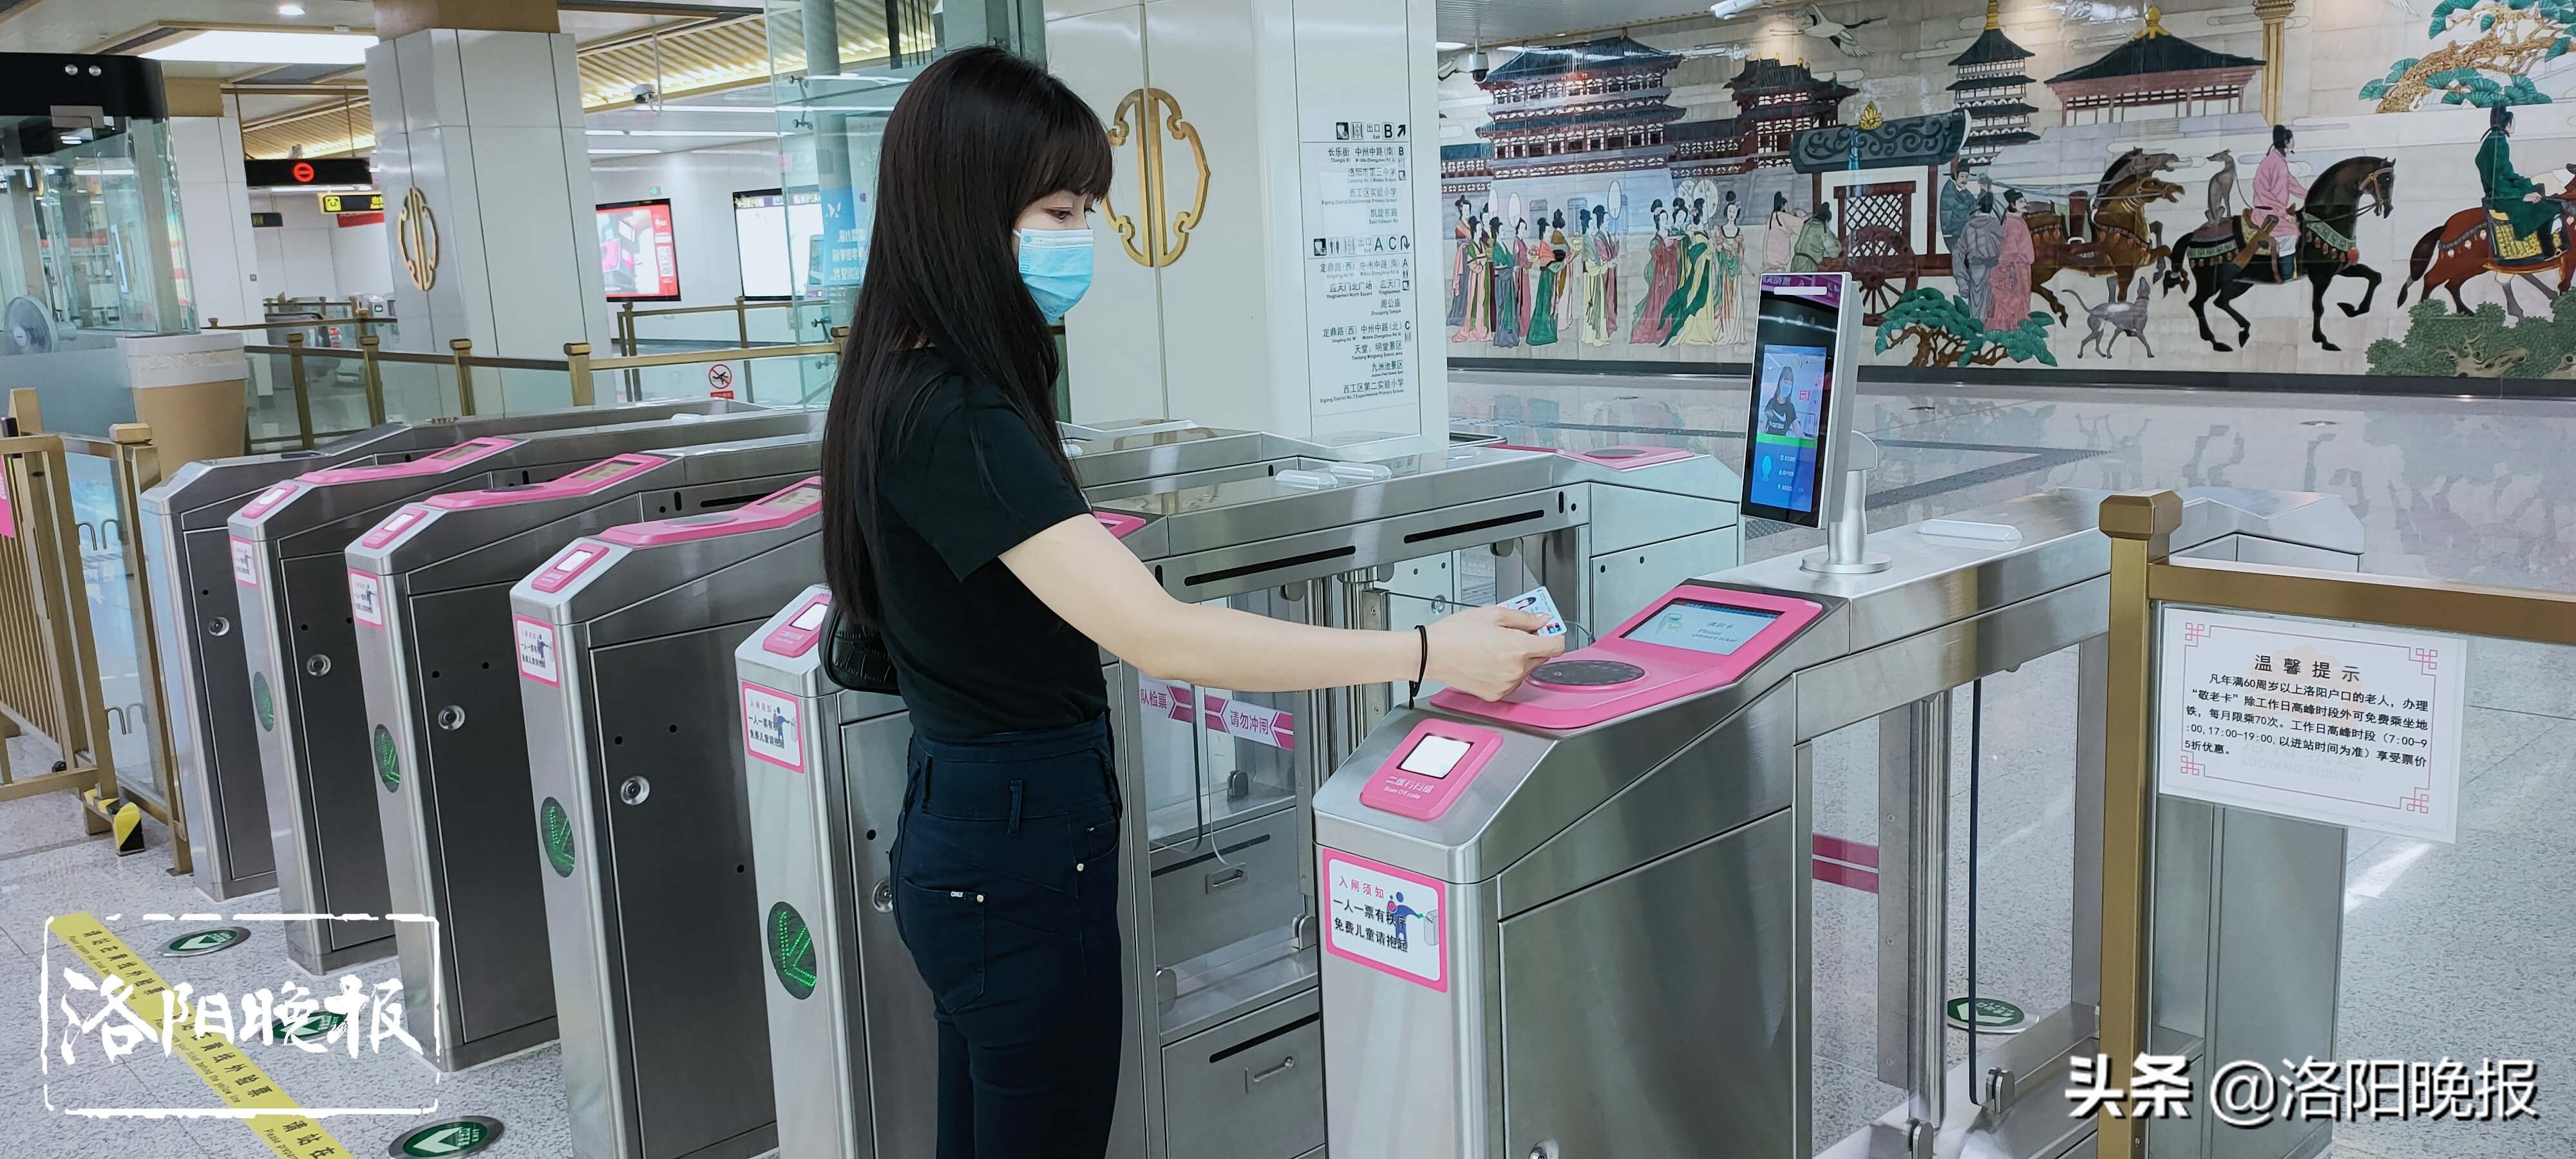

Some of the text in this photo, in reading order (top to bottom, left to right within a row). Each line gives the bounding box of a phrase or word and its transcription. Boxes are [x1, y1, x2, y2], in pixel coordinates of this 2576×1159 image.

[1367, 123, 1392, 138] 出口 B
[1328, 146, 1350, 156] 长乐街
[1399, 146, 1404, 156] B
[1358, 236, 1397, 251] 出口 A C
[1403, 258, 1408, 268] A
[1405, 321, 1410, 330] C
[2254, 654, 2361, 683] 温馨提示
[1140, 688, 1167, 710] 队检票
[1230, 710, 1269, 735] 请勿冲闸
[2184, 739, 2231, 756] 5折优惠。
[1339, 876, 1384, 899] 入闸须知
[1332, 898, 1407, 929] 一人一票有秩序
[1334, 917, 1408, 952] 免费儿童请抱起
[263, 1127, 281, 1144] Please
